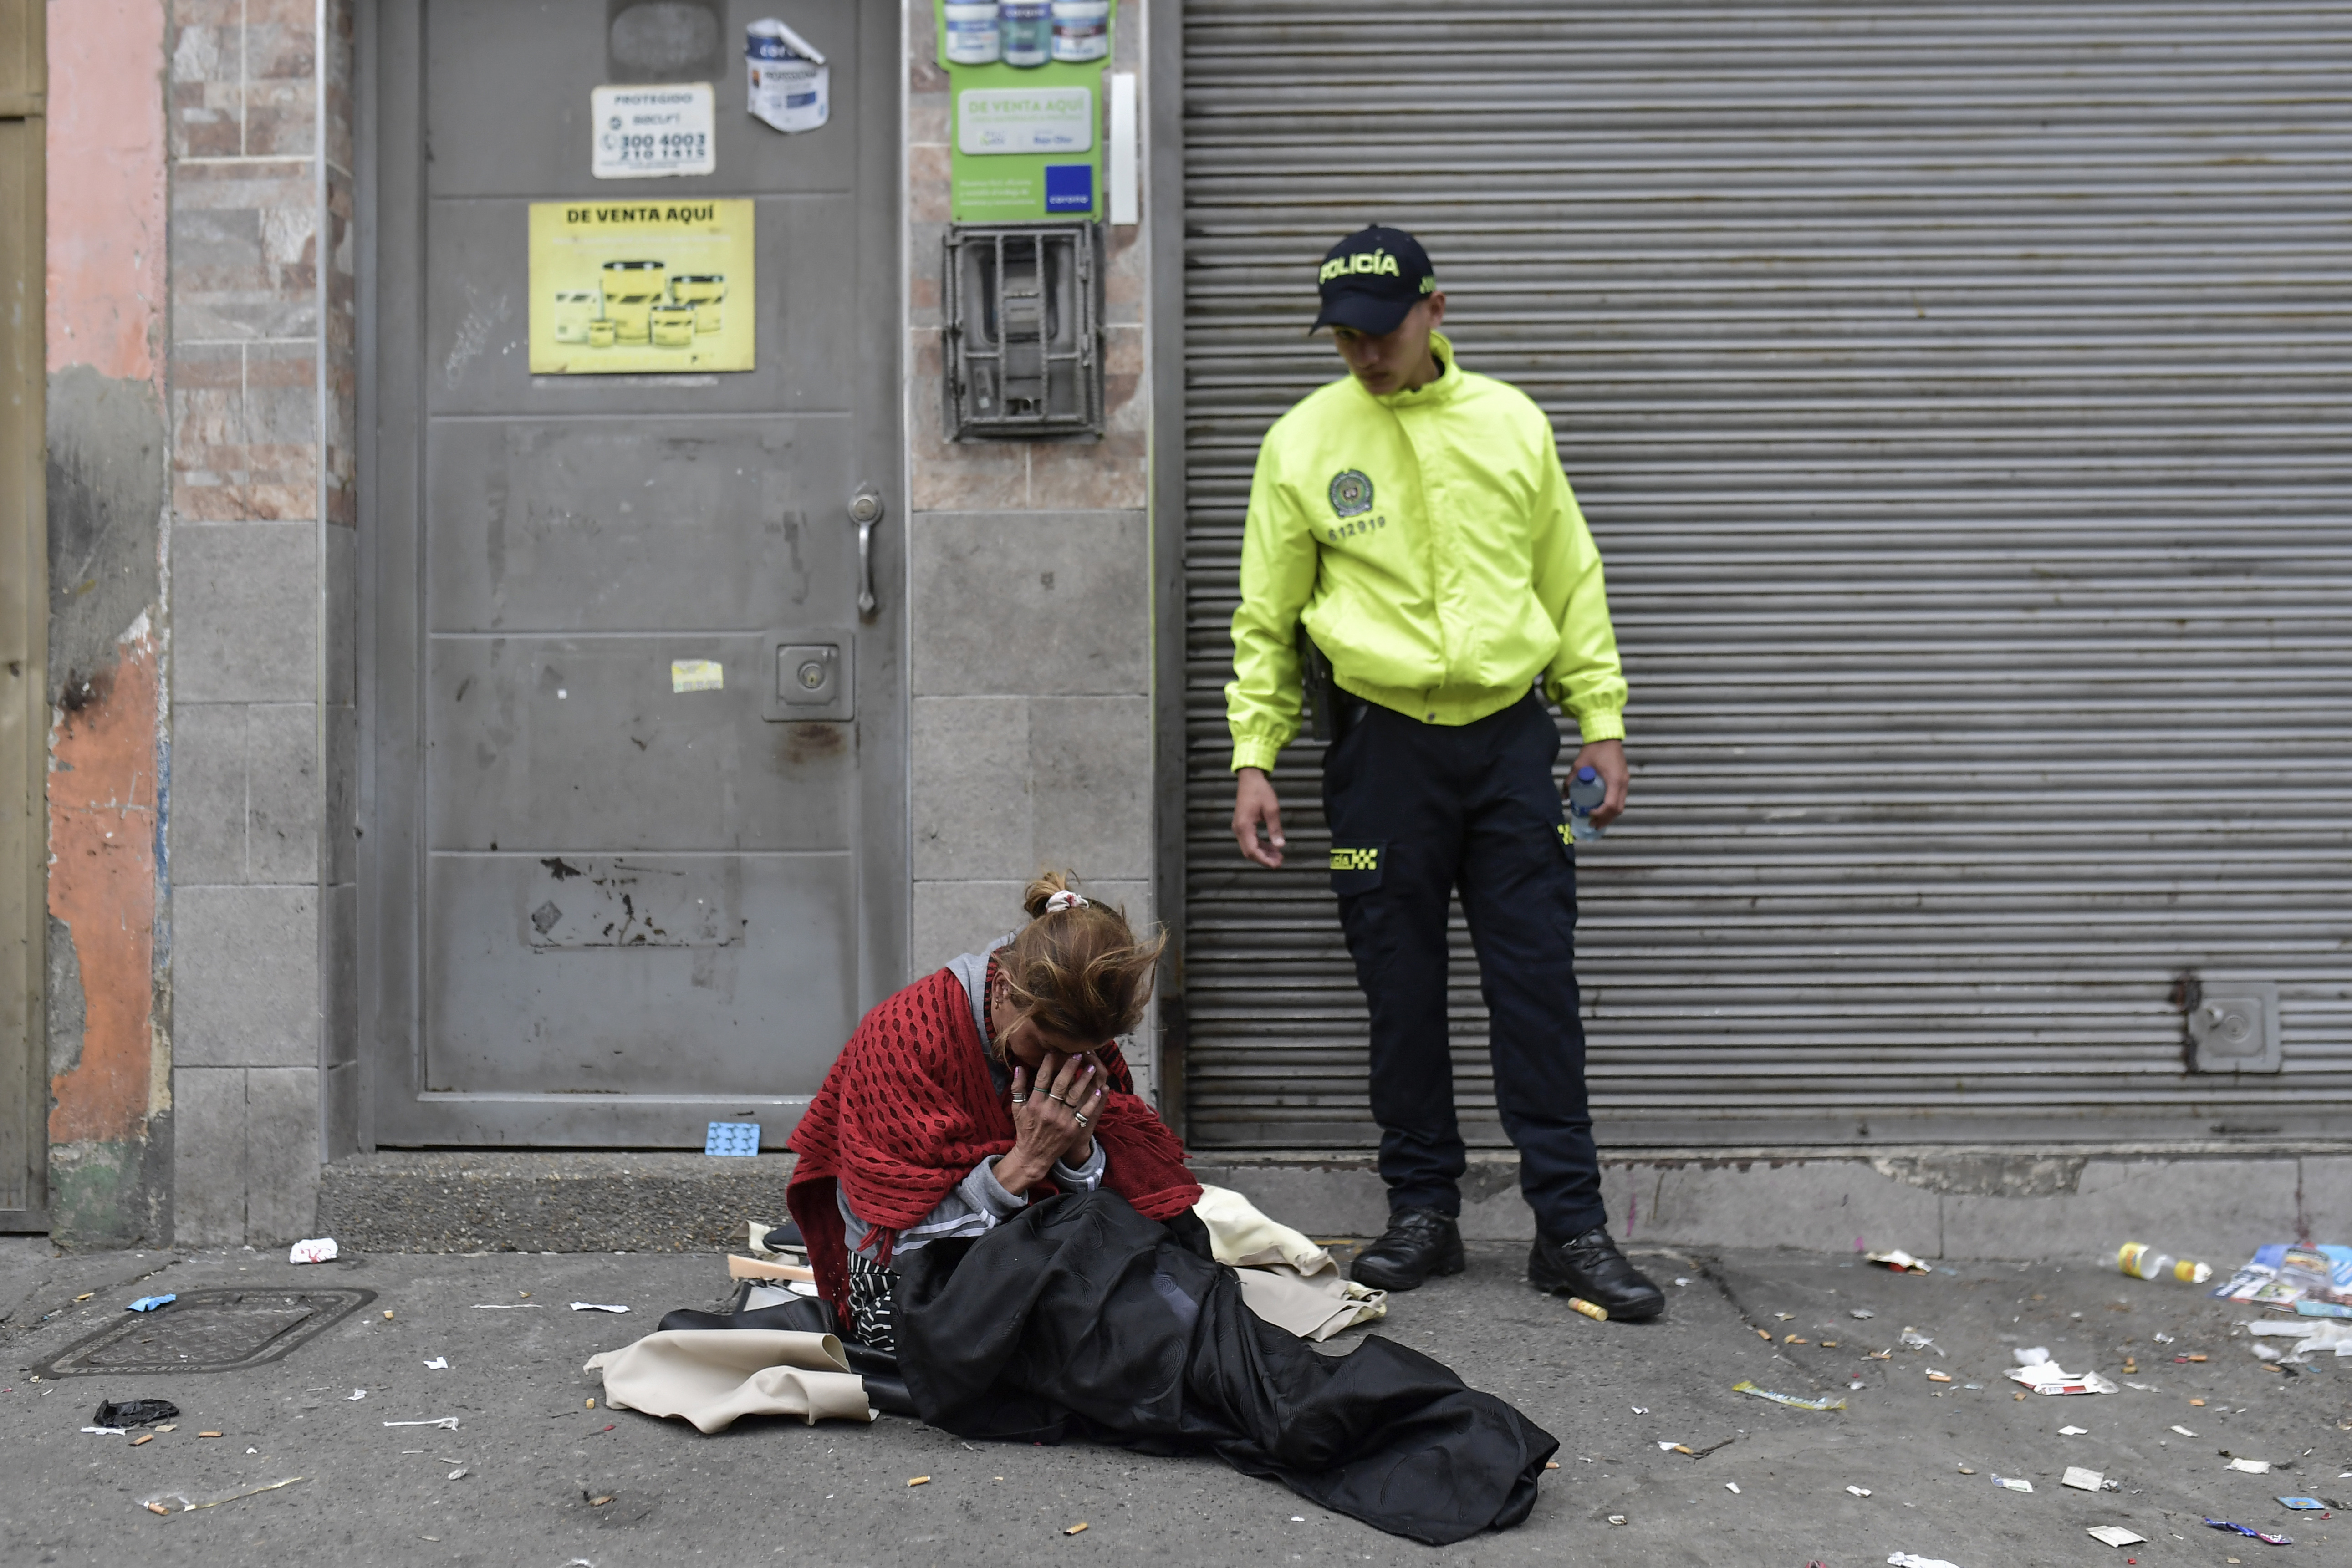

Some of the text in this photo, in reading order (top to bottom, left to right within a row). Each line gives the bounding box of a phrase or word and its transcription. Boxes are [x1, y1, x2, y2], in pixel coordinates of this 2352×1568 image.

[615, 93, 693, 105] PROTEGIDO
[969, 96, 1084, 114] DE VENTA AQUÍ
[567, 204, 714, 225] DE VENTA AQUÍ
[1320, 247, 1400, 285] POLICÍA
